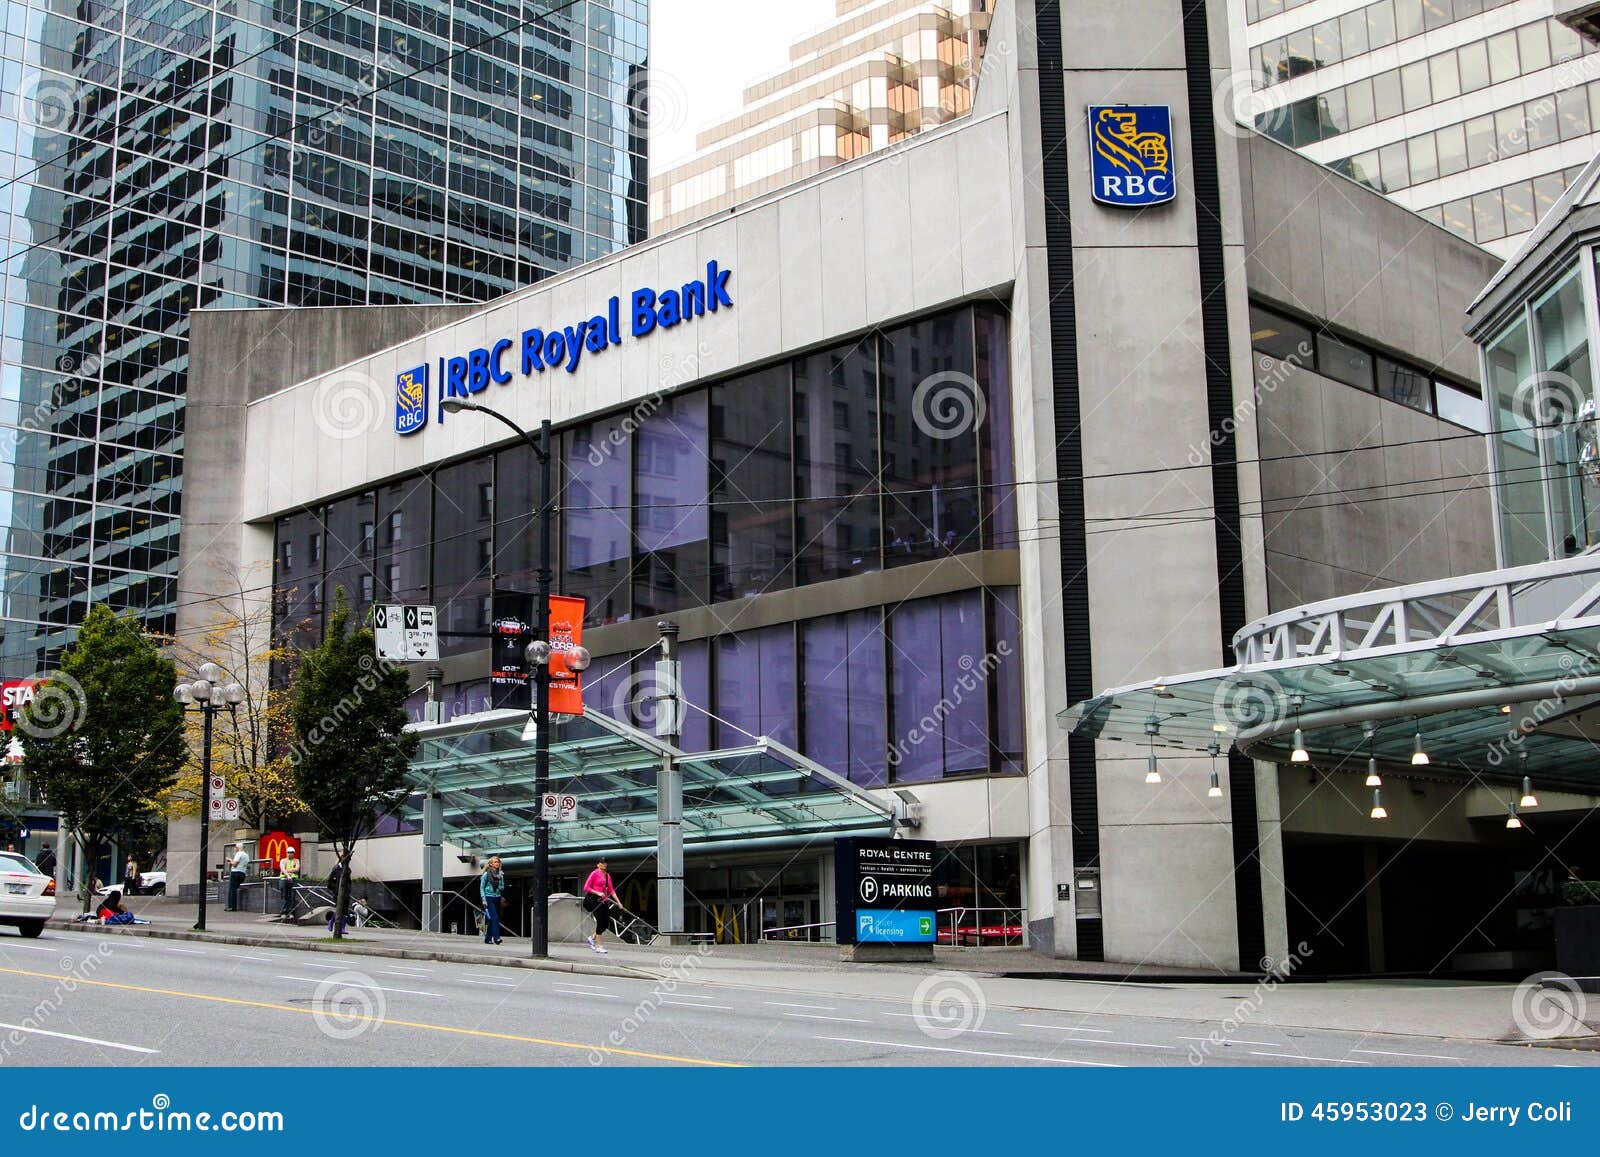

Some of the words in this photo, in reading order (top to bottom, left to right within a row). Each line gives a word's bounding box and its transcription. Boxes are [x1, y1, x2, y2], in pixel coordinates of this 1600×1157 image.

[1101, 175, 1168, 197] RBC
[447, 338, 514, 399] RBC
[521, 296, 622, 374] Royal
[631, 259, 734, 338] Bank
[398, 409, 422, 429] RBC
[492, 677, 528, 685] FESTIVAL
[859, 848, 891, 858] ROYAL
[893, 850, 932, 860] CENTRE
[865, 881, 875, 898] P
[882, 883, 932, 898] PARKING
[876, 927, 904, 937] licensing
